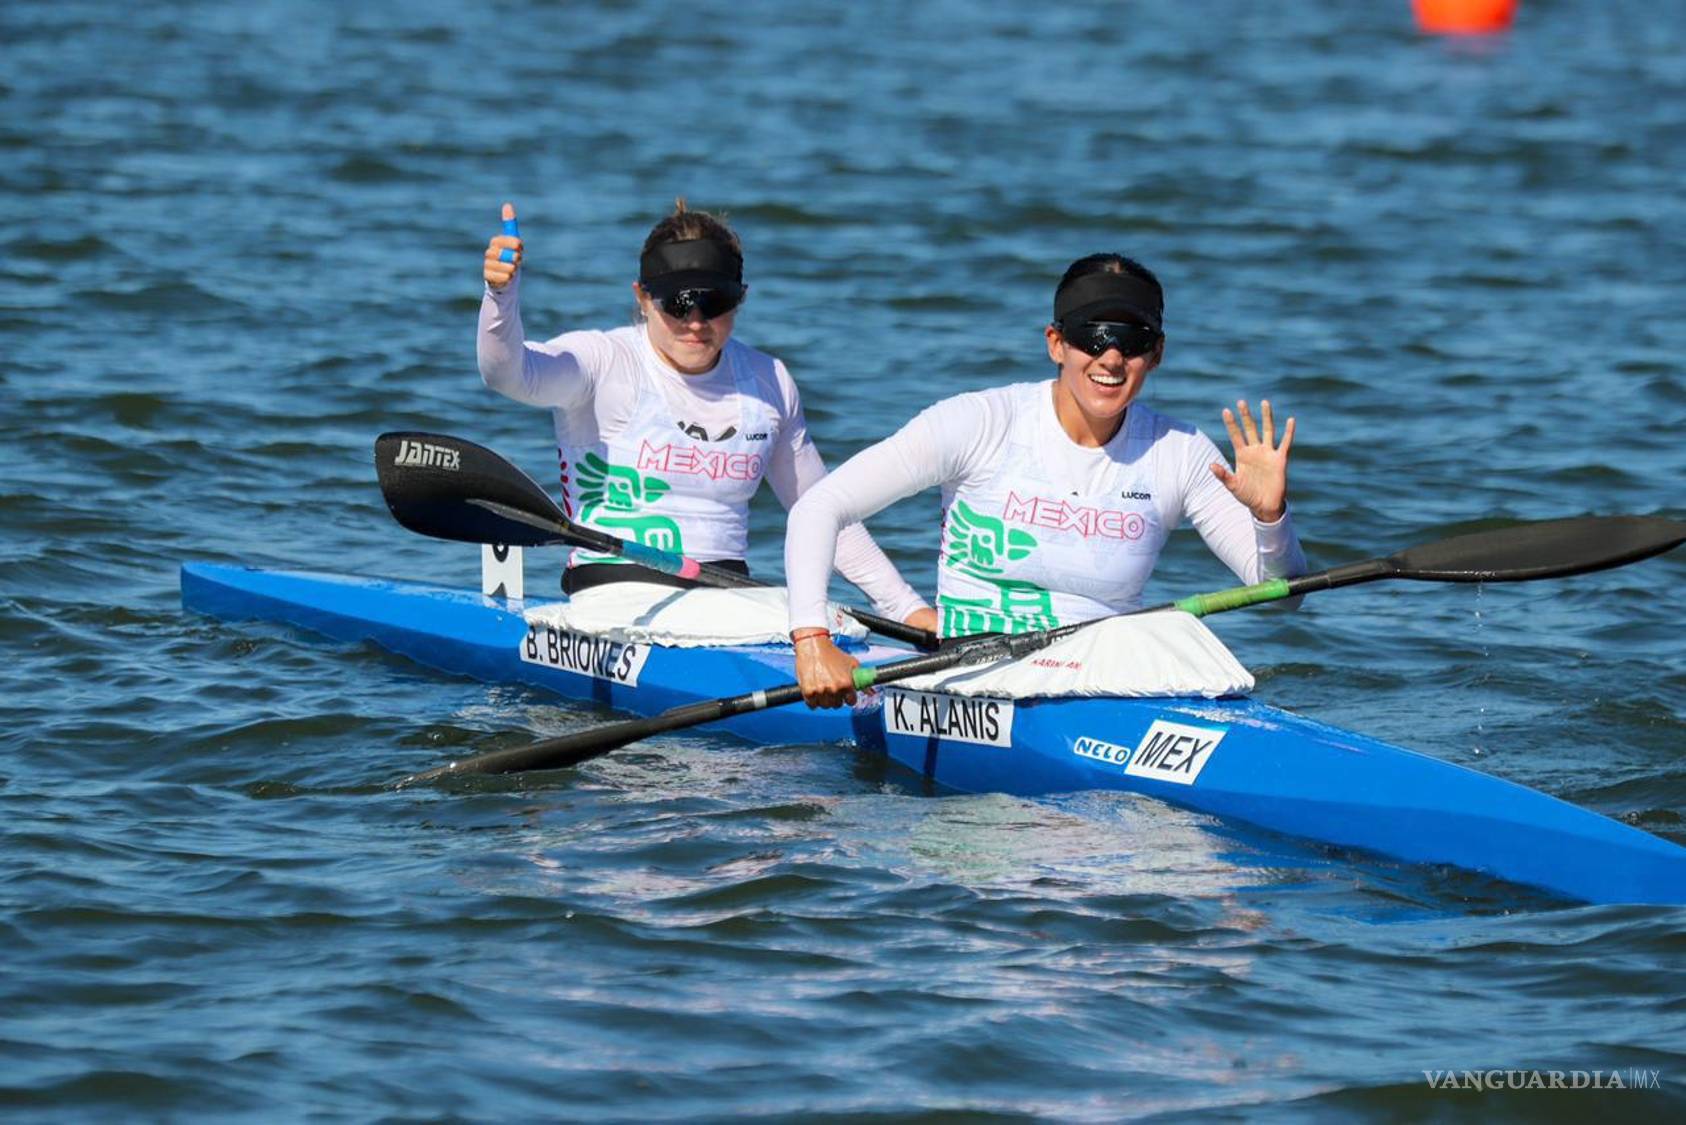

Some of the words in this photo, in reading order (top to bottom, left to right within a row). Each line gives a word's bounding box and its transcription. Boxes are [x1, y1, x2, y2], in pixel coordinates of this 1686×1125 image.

[637, 438, 763, 480] MEXICO
[1003, 490, 1145, 540] MEXICO
[527, 625, 543, 661] B.
[547, 628, 636, 681] BRIONES
[893, 692, 914, 731] K.
[920, 695, 999, 741] ALANIS
[1134, 731, 1213, 773] MEX
